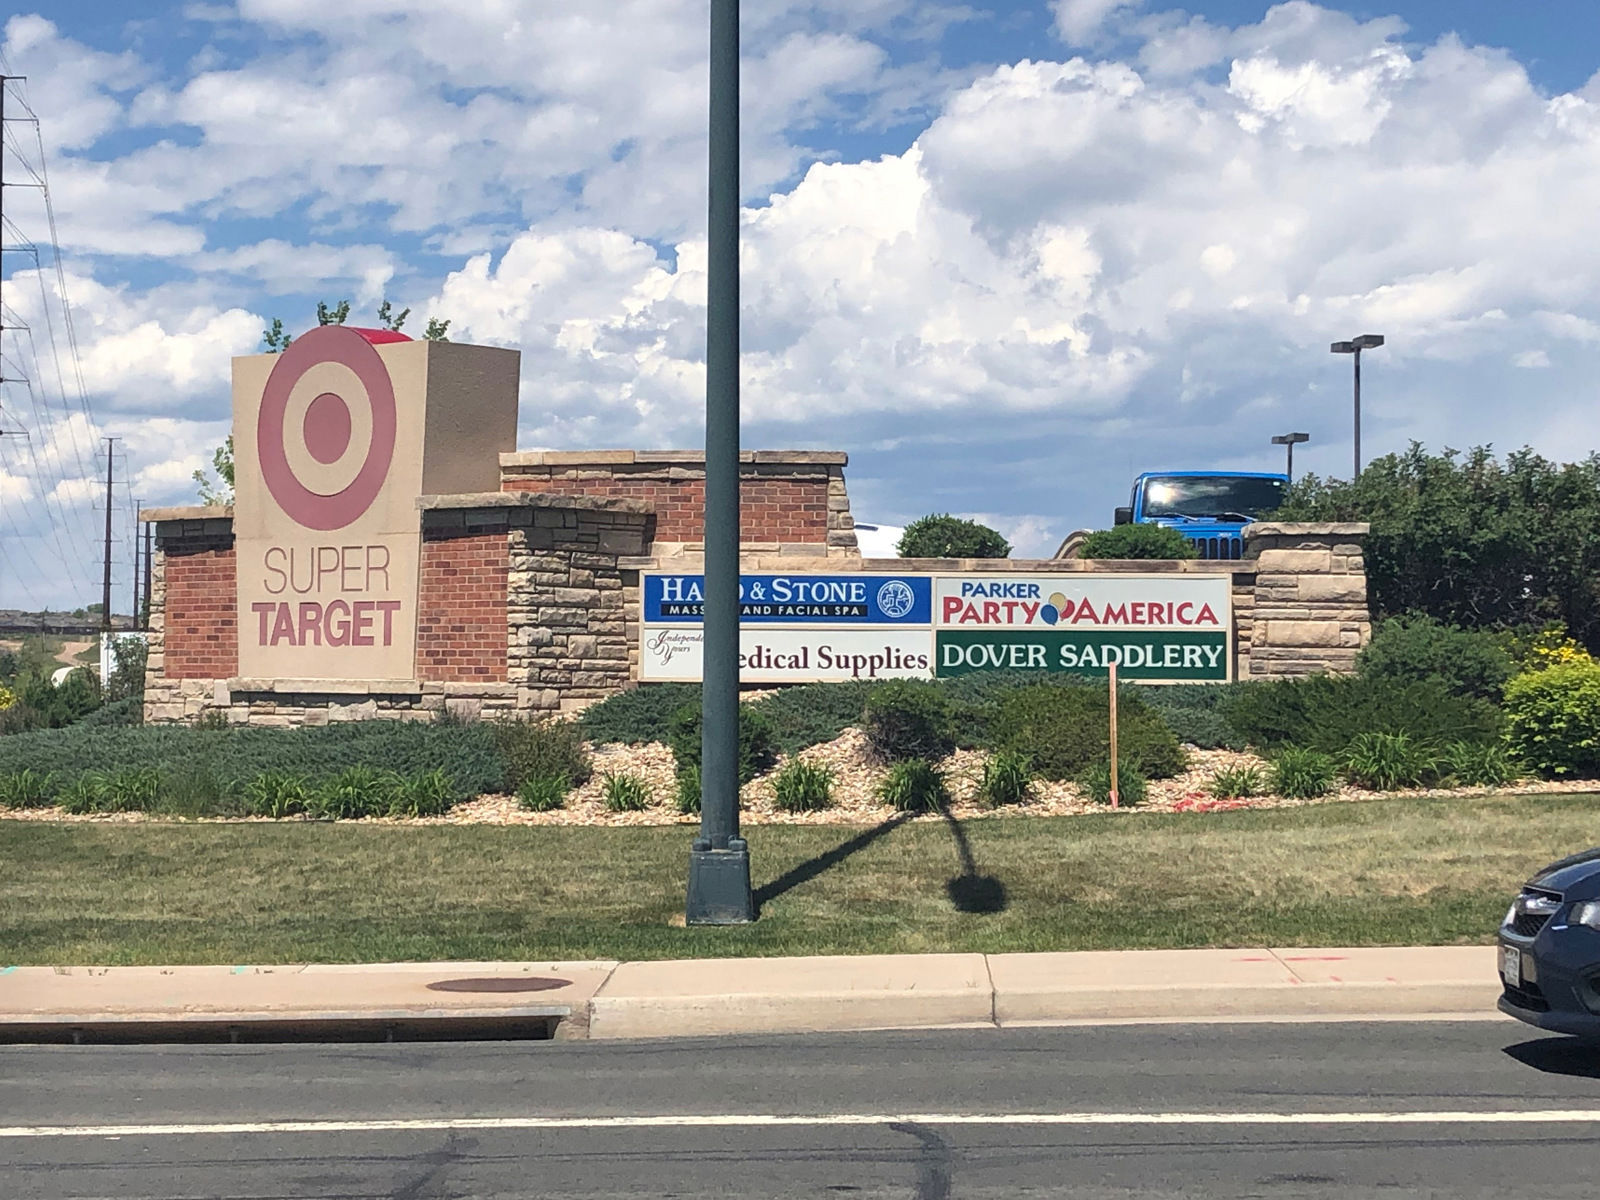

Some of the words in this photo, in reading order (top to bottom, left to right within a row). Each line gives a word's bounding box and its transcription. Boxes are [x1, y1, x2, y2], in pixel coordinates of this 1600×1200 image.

[264, 545, 390, 594] SUPER
[750, 582, 766, 600] &
[772, 578, 866, 602] STONE
[961, 582, 1040, 598] PARKER
[252, 599, 401, 647] TARGET
[743, 606, 771, 615] AND
[778, 606, 828, 616] FACIAL
[834, 606, 860, 616] SPA
[943, 597, 1040, 624] PARTY
[1070, 597, 1219, 625] AMERICA
[738, 645, 810, 669] edical
[817, 645, 928, 677] Supplies
[943, 644, 1048, 668] DOVER
[1060, 644, 1223, 668] SADDLERY
